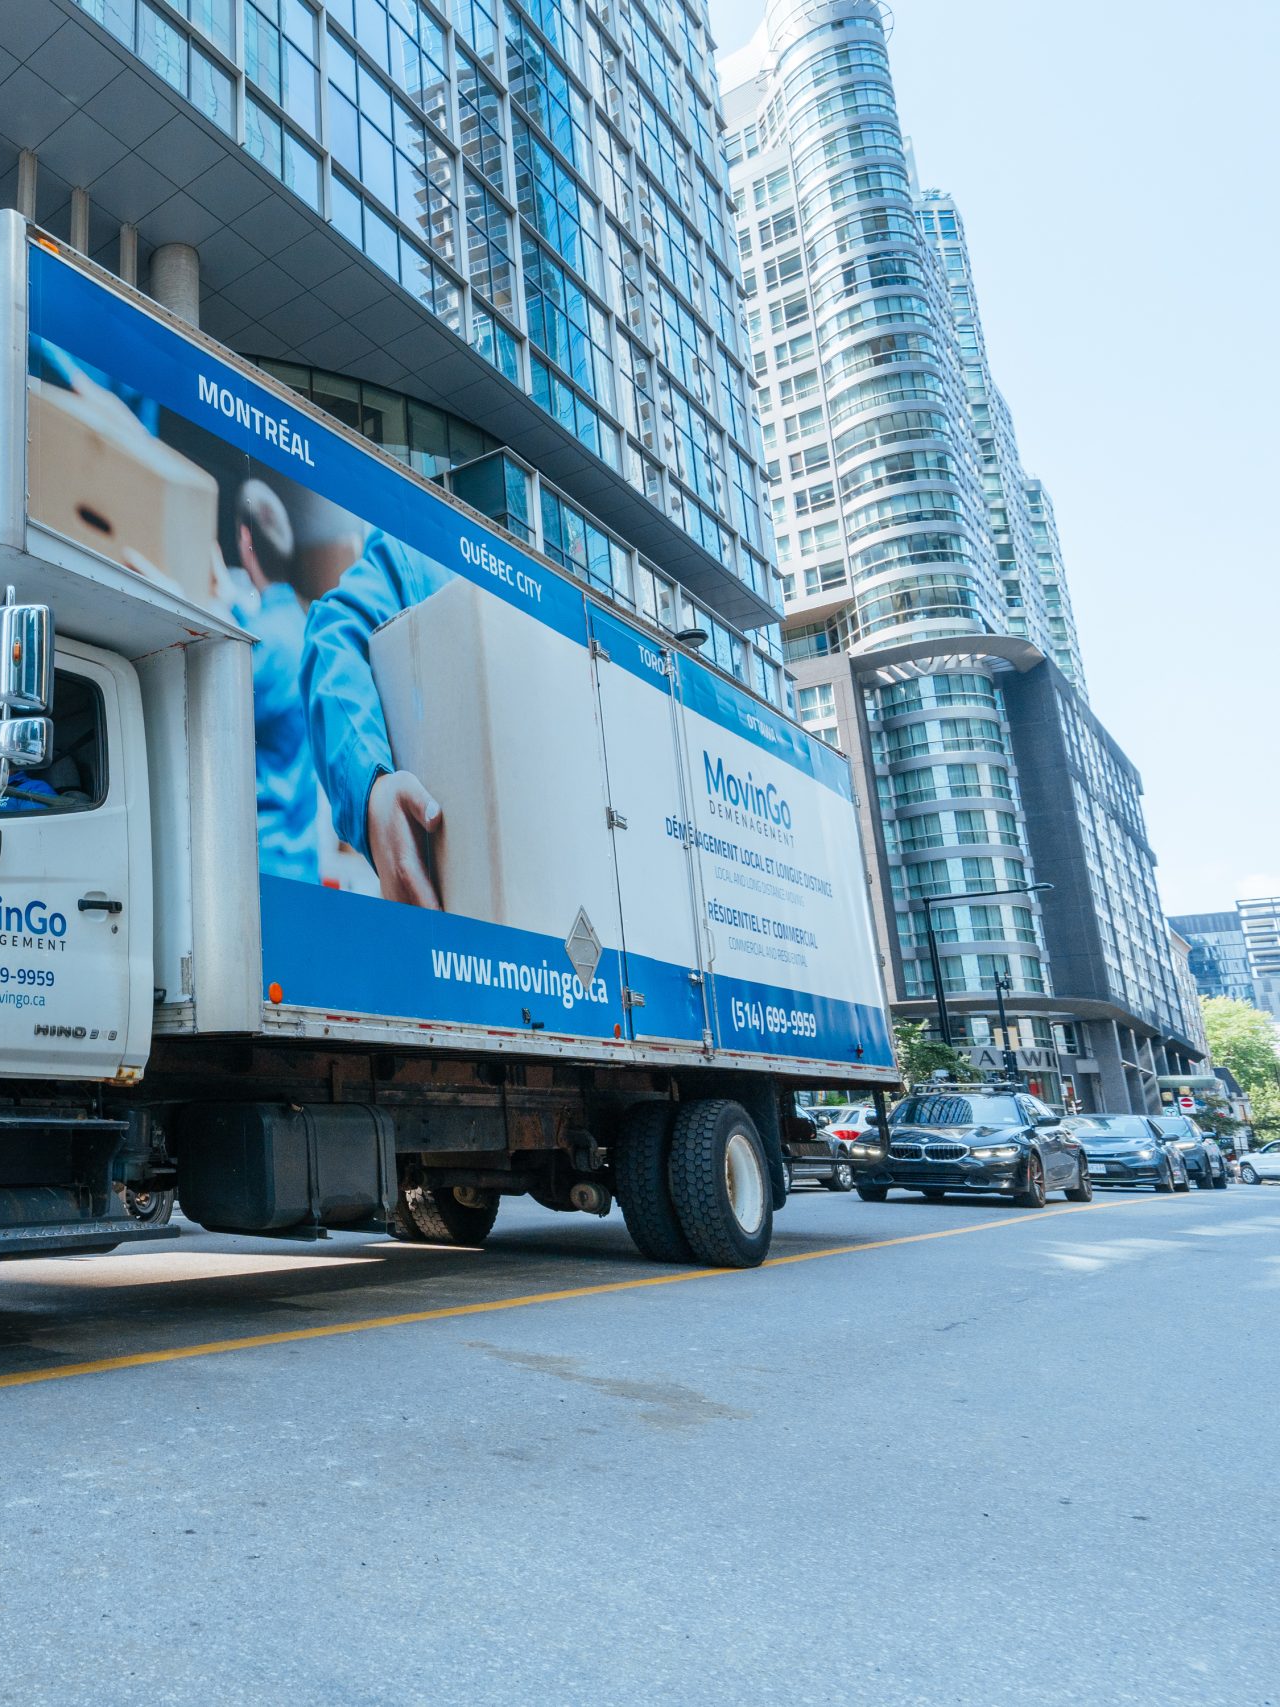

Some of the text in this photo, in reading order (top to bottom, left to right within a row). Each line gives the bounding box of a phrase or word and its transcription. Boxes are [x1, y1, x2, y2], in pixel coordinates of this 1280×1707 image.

[198, 373, 315, 467] MONTRÉAL
[459, 536, 542, 603] QUÉBEC CITY
[703, 750, 792, 830] MovinGo
[709, 800, 795, 848] DEMENAGEMENT
[739, 847, 765, 872] LOCAL
[765, 857, 775, 875] ET
[775, 861, 804, 887] LONGUE
[803, 872, 833, 898] DISTANCE
[707, 897, 818, 949] RÉSIDENTIEL ET COMMERCIAL
[431, 949, 609, 1009] www.movingo.ca
[34, 1023, 87, 1039] HINO
[731, 996, 817, 1038] (514) 699-9959
